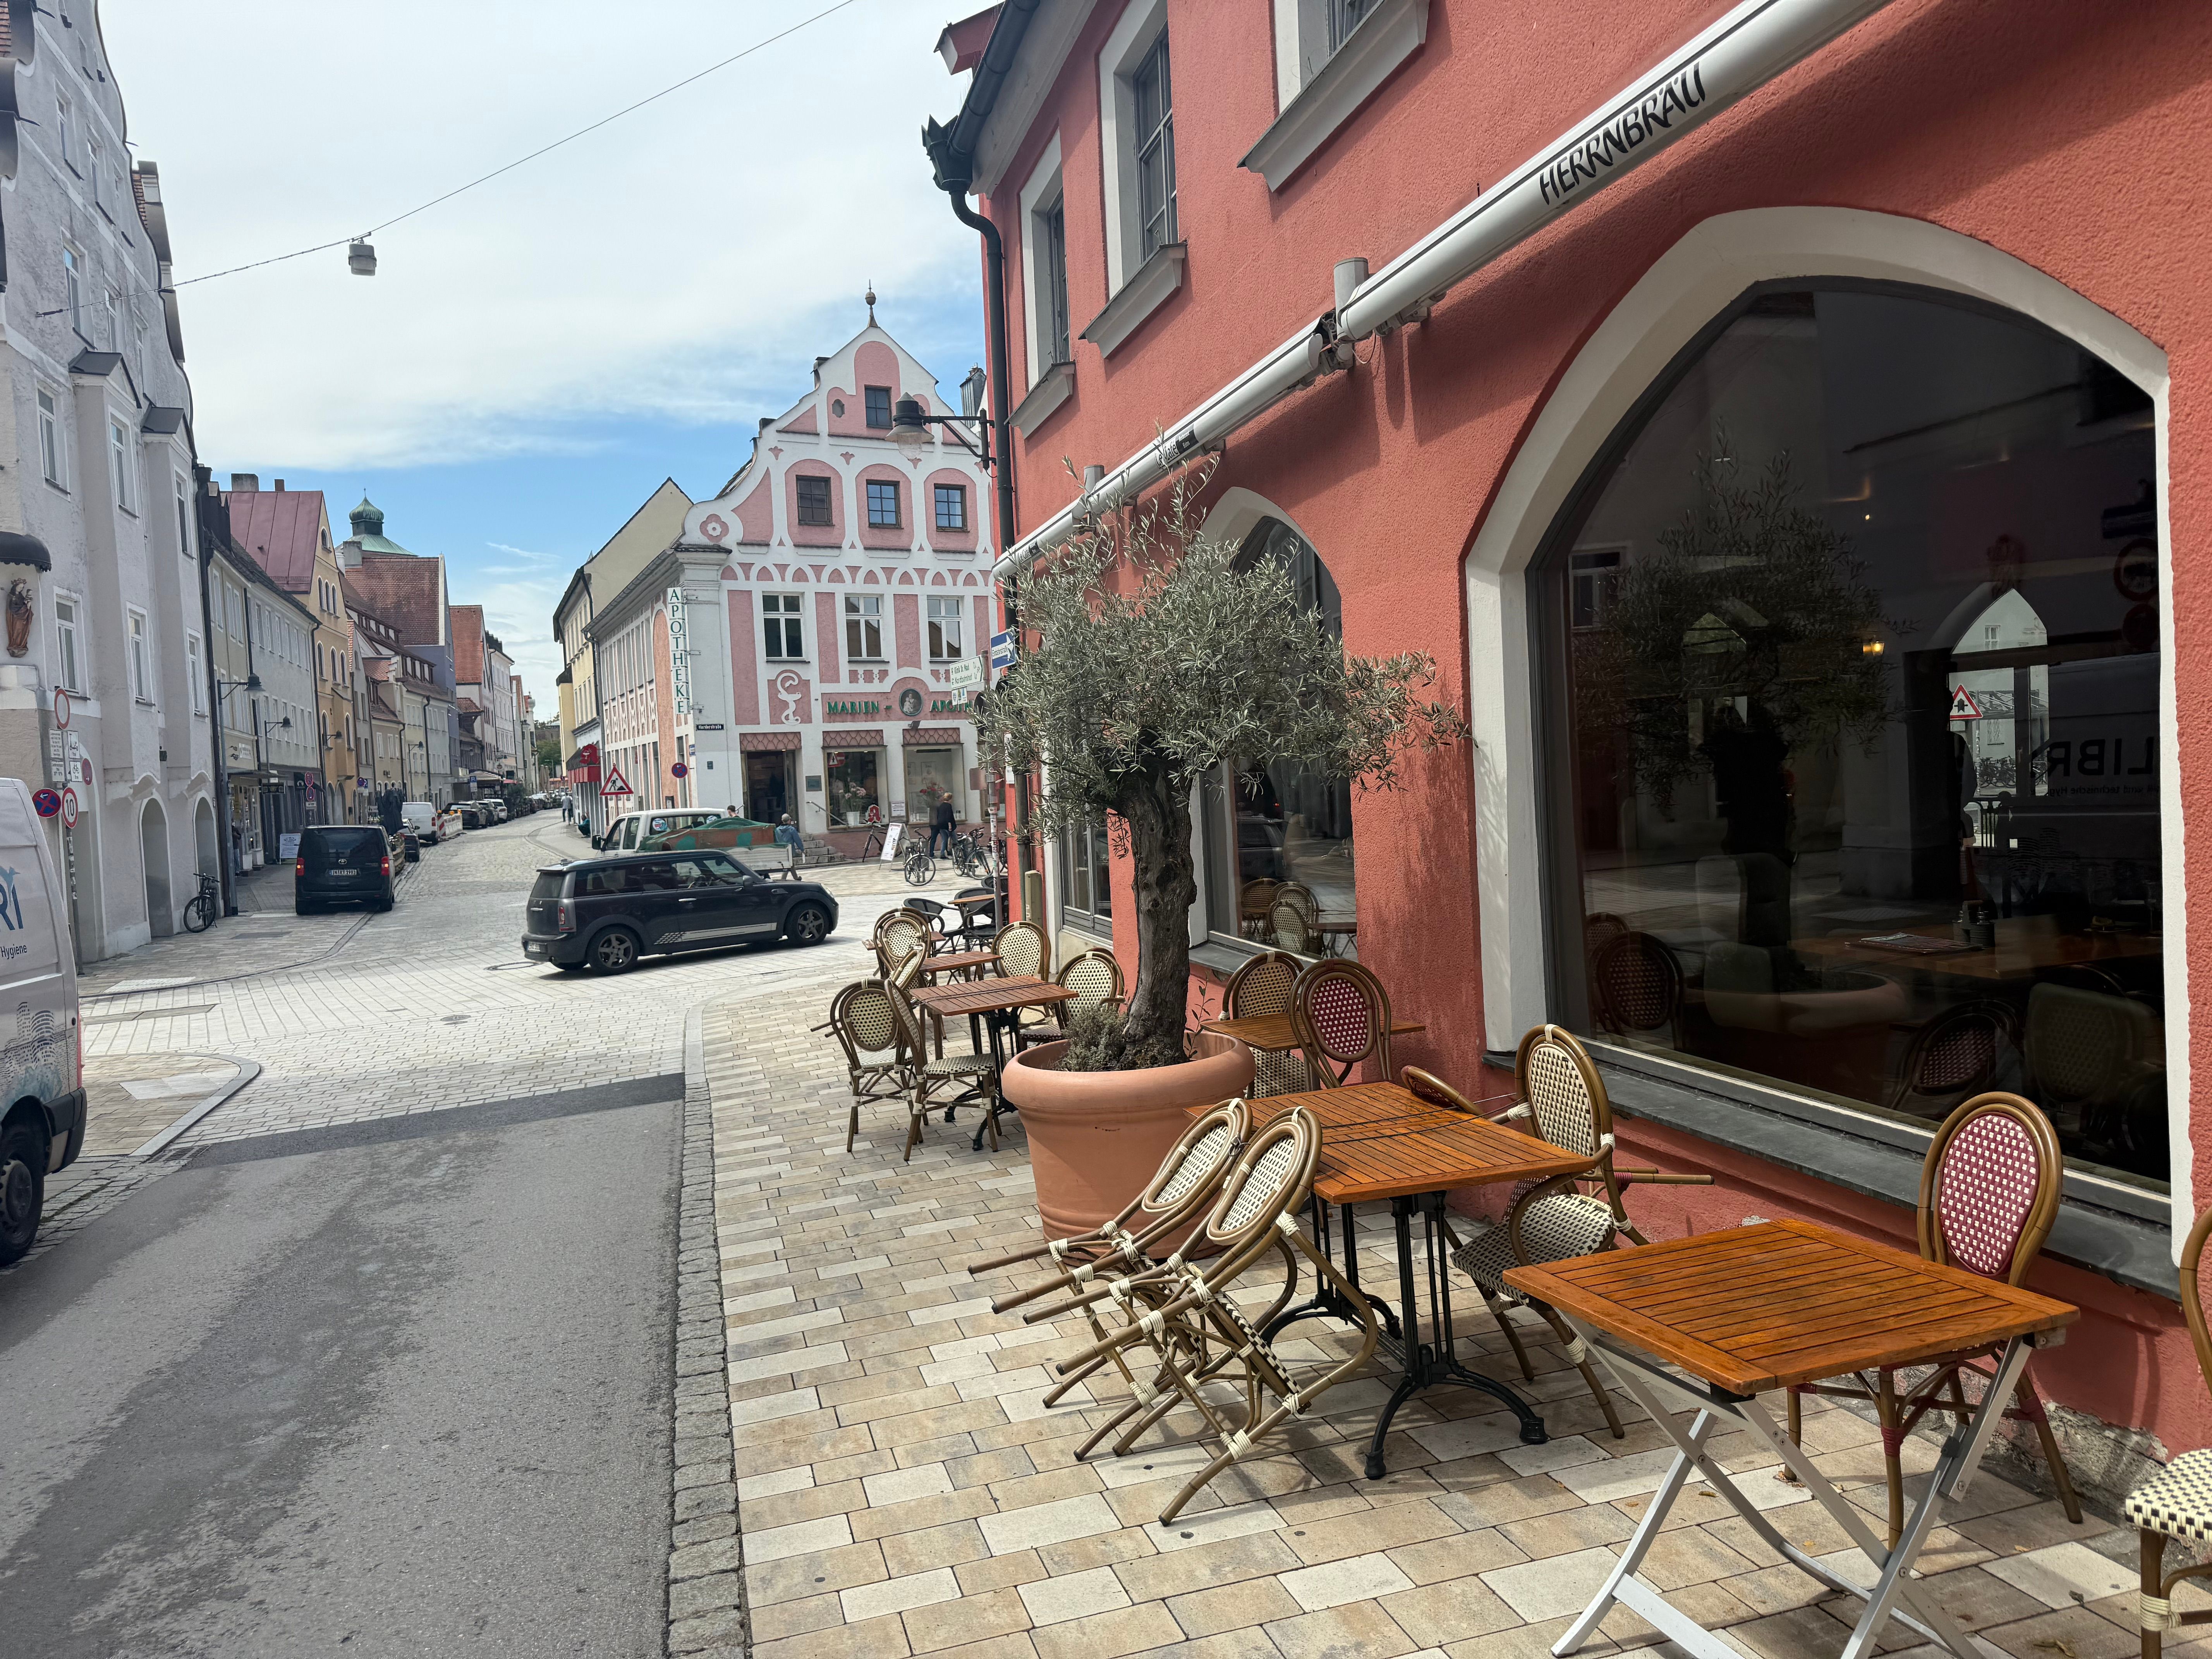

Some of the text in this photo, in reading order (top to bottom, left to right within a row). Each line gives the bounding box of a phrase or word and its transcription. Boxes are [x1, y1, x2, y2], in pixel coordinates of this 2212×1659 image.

[1539, 61, 1705, 205] HERRNBRÄU
[670, 589, 685, 713] APOTHEKE
[826, 701, 879, 713] MARIEN
[66, 799, 74, 817] 10
[1, 944, 27, 960] Hygiene
